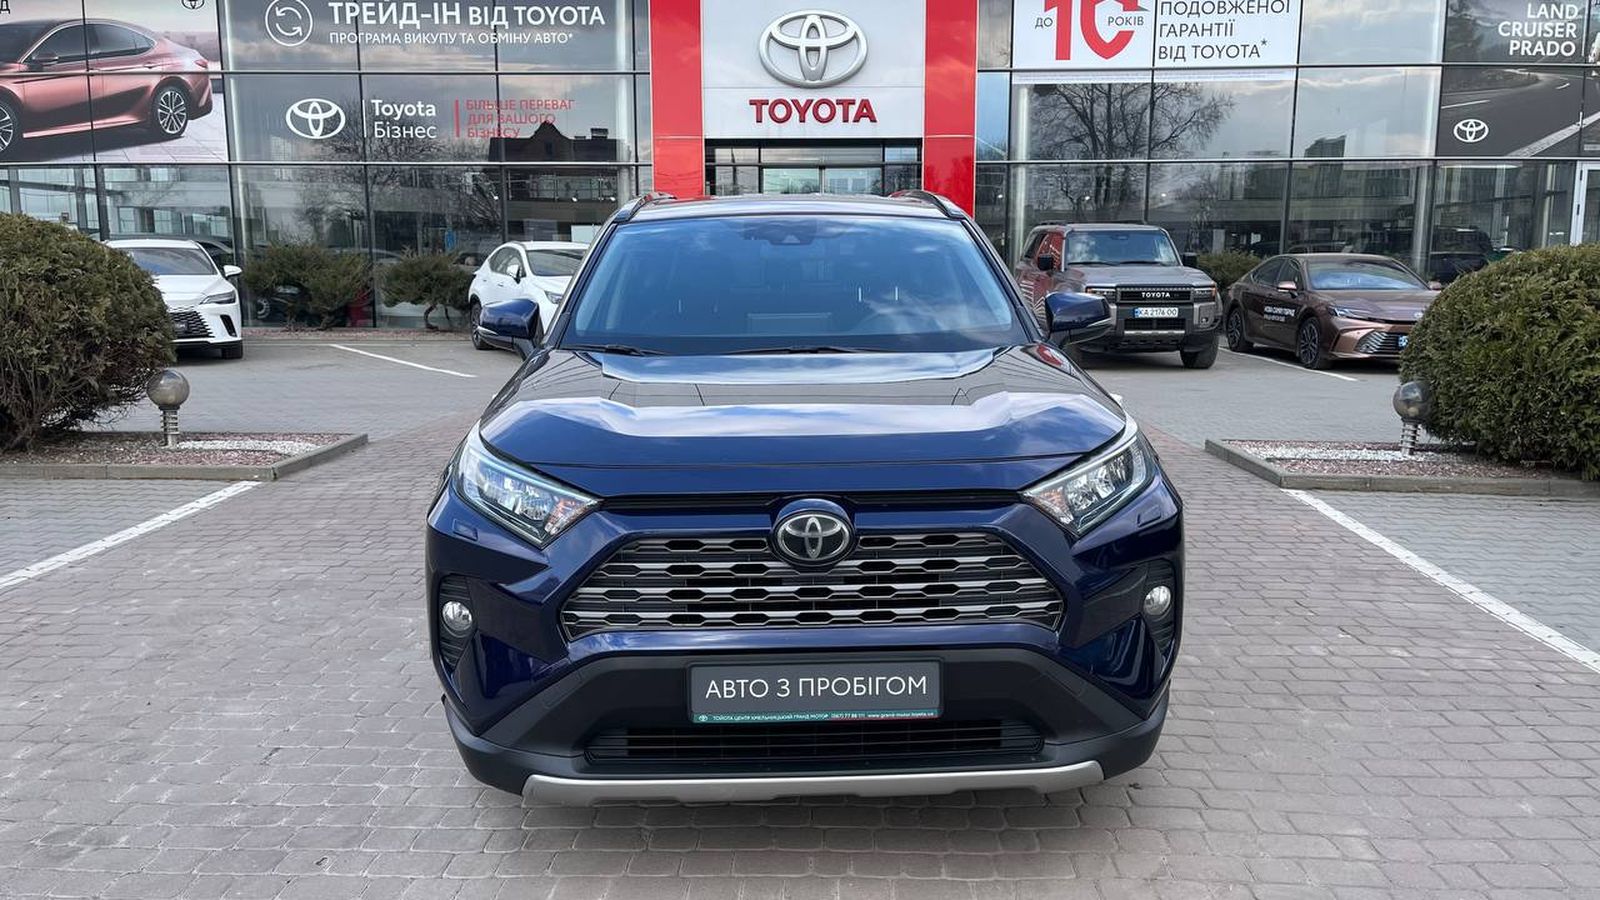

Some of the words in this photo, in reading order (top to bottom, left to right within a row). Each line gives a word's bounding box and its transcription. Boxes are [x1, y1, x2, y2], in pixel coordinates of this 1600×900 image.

[328, 0, 461, 29] ТРЕЙД-ІН
[469, 6, 509, 29] ВІД
[513, 6, 606, 26] TOYOTA
[1526, 3, 1579, 19] LAND
[1035, 17, 1053, 29] ДО
[1107, 16, 1144, 26] РОКІВ
[1159, 19, 1235, 38] ГАРАНТІЇ
[1498, 21, 1577, 38] CRUISER
[329, 32, 401, 44] ПРОГРАМА
[404, 33, 457, 44] ВИКУПУ
[460, 33, 476, 44] ТА
[478, 33, 531, 44] ОБМІНУ
[1159, 45, 1186, 62] ВІД
[1509, 40, 1576, 57] PRADO
[371, 100, 436, 121] Toyota
[520, 99, 575, 111] ПЕРЕВАГ
[748, 98, 878, 124] TOYOTA
[467, 113, 494, 125] ДЛЯ
[374, 121, 437, 138] Бізнес
[1141, 291, 1171, 299] TOYOTA
[705, 678, 769, 699] АВТО
[799, 675, 927, 697] ПРОБІГОМ
